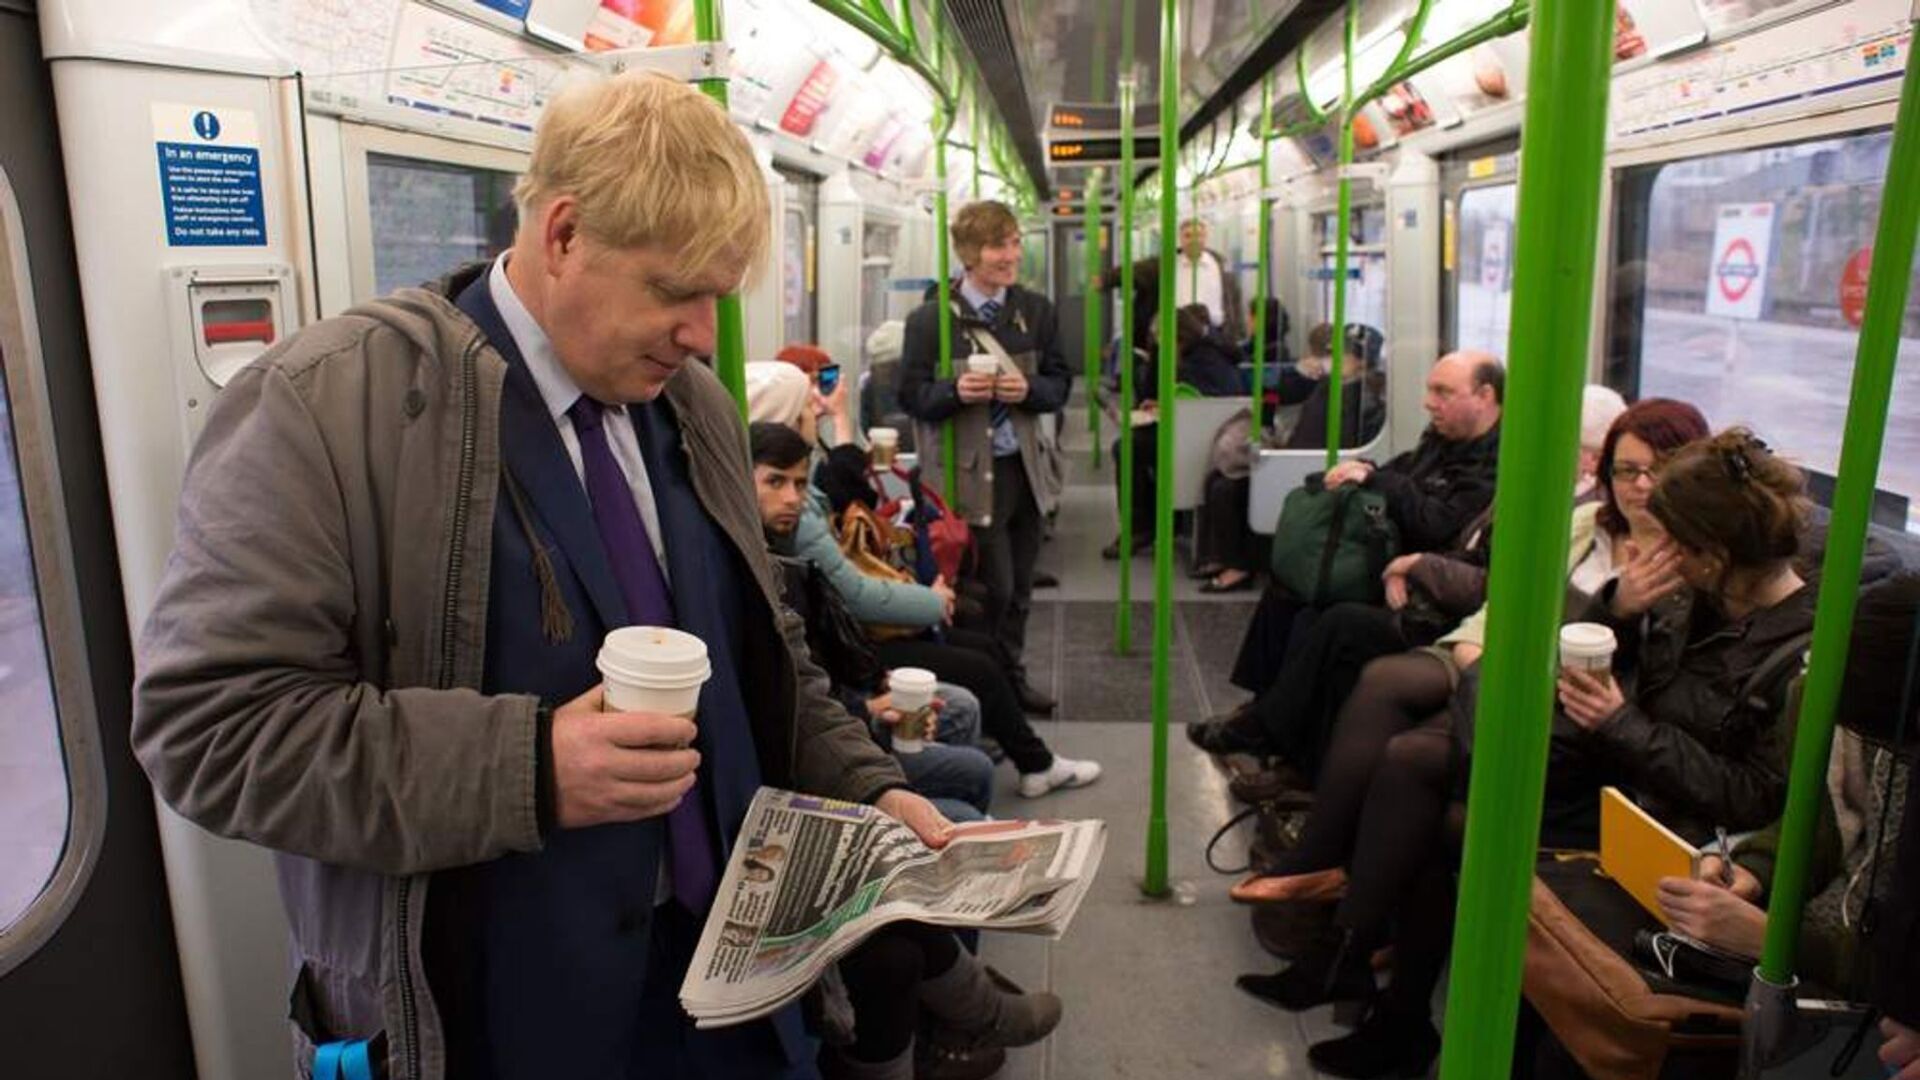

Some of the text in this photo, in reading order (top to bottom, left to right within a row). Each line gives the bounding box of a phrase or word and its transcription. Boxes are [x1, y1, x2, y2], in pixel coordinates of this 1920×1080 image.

[165, 148, 252, 164] In an emergency
[175, 227, 188, 236] Do
[190, 227, 204, 236] not
[206, 227, 224, 236] take
[226, 228, 240, 237] any
